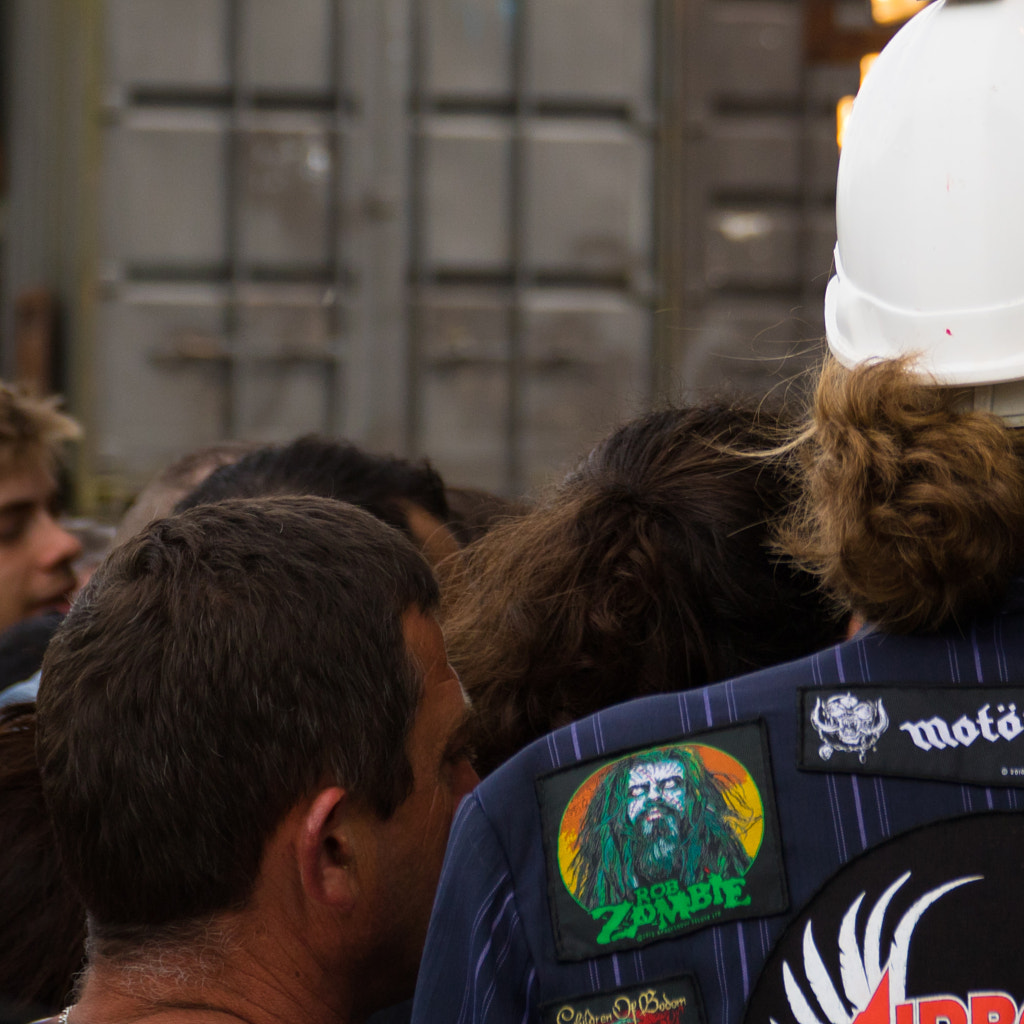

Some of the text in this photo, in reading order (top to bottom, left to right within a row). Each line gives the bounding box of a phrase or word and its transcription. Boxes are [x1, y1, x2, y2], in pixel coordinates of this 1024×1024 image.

[591, 872, 752, 944] ZOMBIE
[635, 879, 680, 908] ROB
[638, 989, 686, 1016] Bodom
